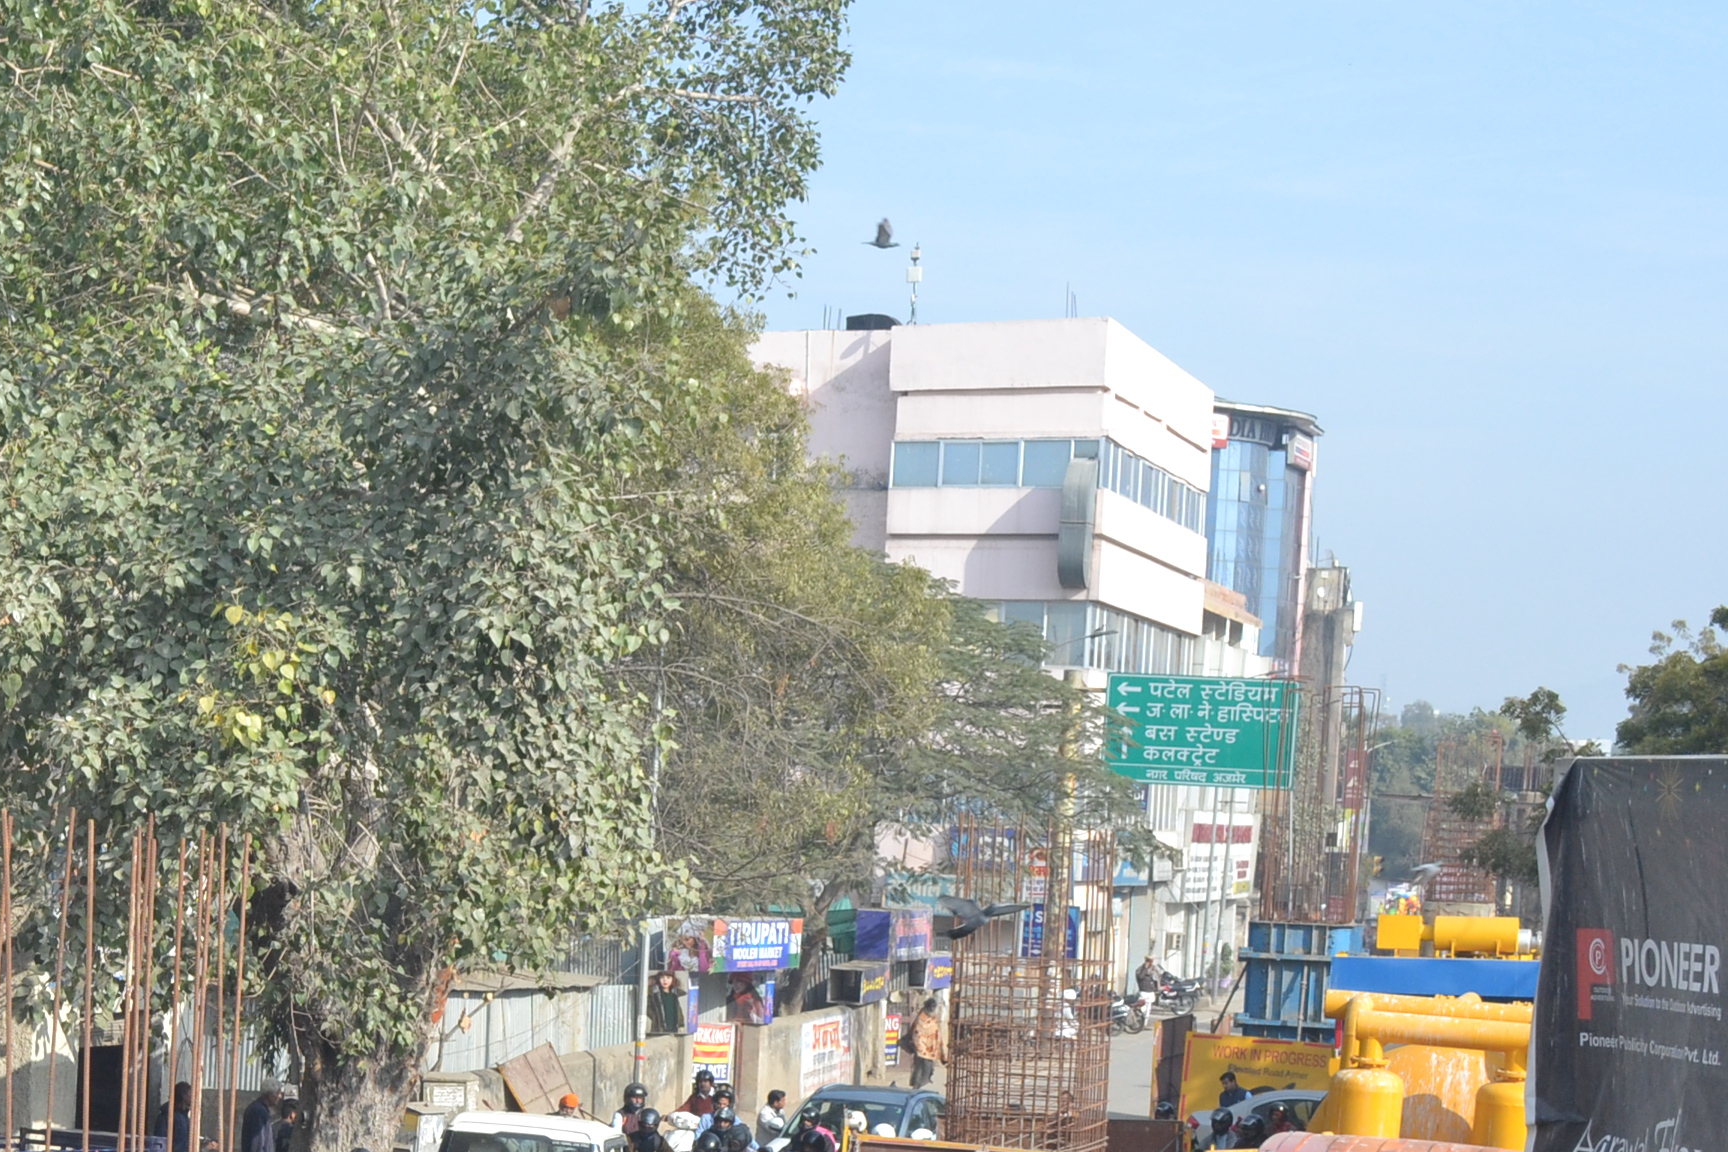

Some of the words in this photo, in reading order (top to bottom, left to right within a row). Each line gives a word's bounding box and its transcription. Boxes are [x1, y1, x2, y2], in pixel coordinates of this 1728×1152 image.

[1148, 679, 1193, 699] पटेल
[1145, 724, 1178, 741] बस
[1146, 769, 1168, 780] नगर
[1213, 771, 1247, 784] अजमेर
[728, 919, 790, 945] TIRUPATI
[1621, 937, 1720, 994] PIONEER
[1687, 1001, 1722, 1021] Advertising
[1213, 1045, 1247, 1060] WORK
[1250, 1047, 1262, 1062] IN
[1264, 1049, 1328, 1069] PROGRESS
[1579, 1032, 1619, 1049] Pioneer
[1619, 1035, 1648, 1056] Publicity
[1702, 1049, 1722, 1066] Ltd.
